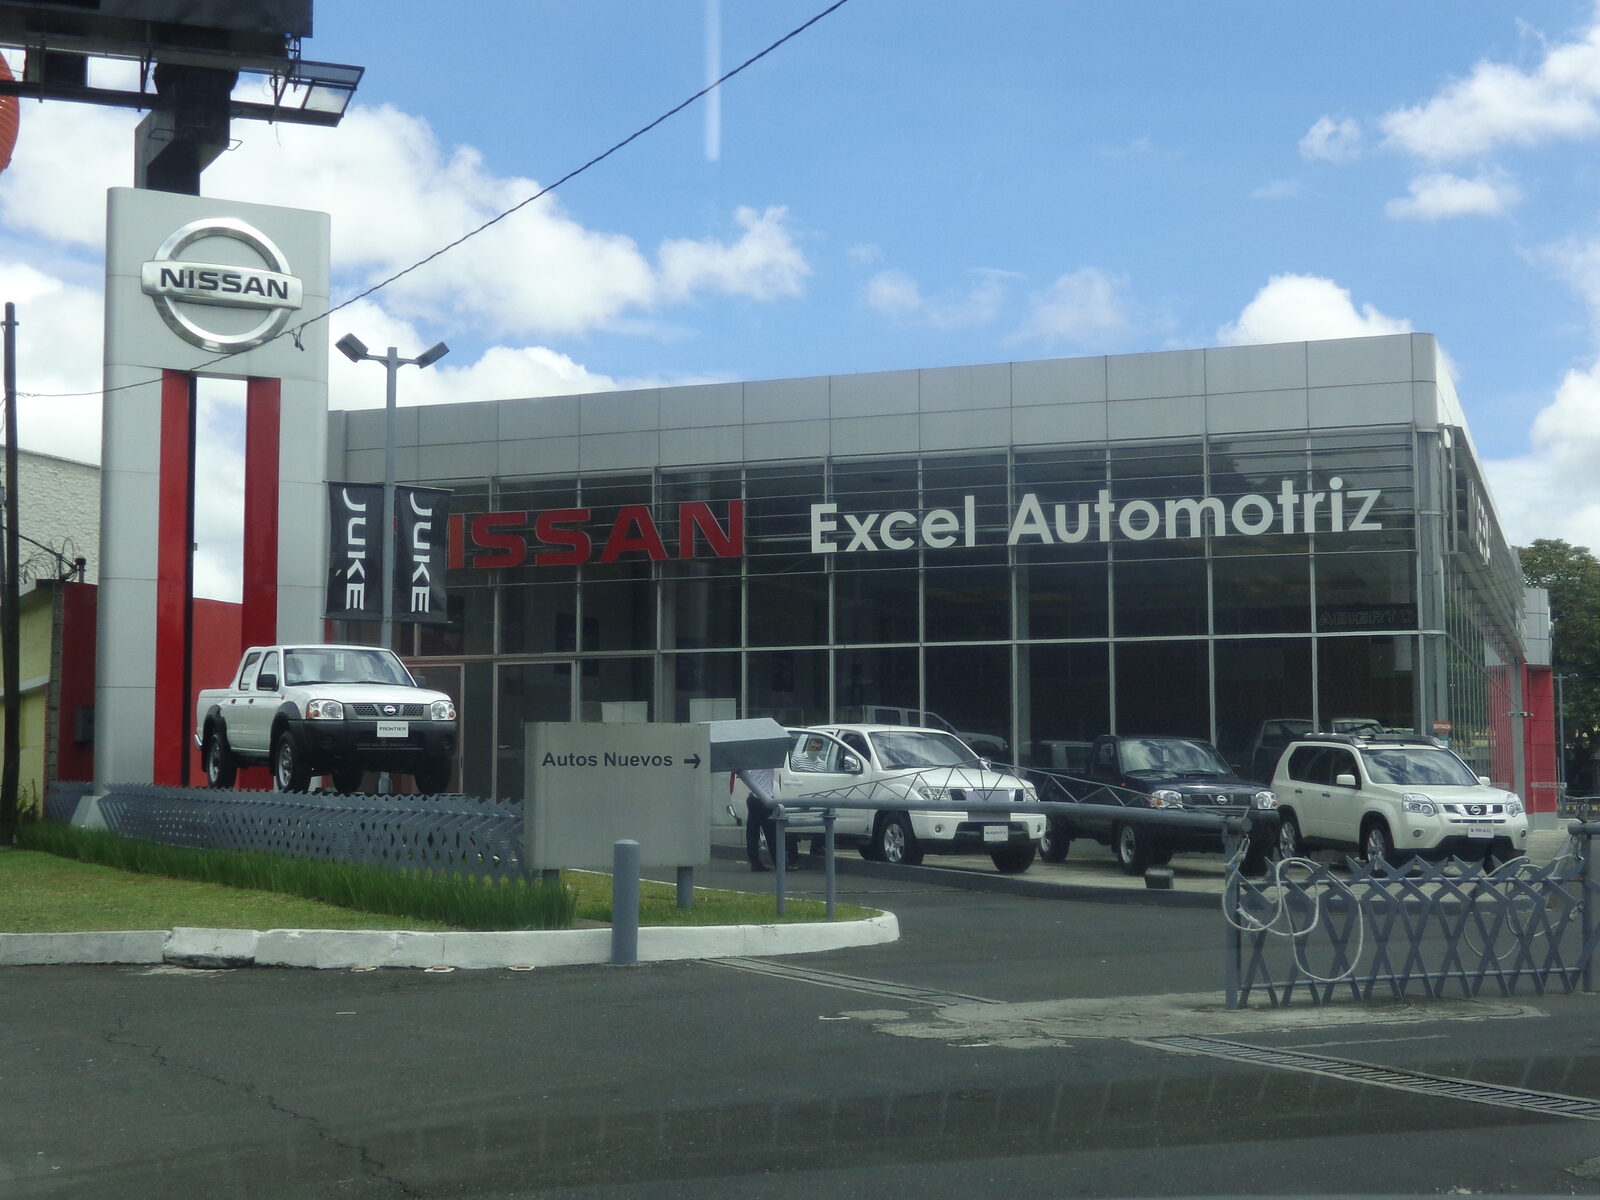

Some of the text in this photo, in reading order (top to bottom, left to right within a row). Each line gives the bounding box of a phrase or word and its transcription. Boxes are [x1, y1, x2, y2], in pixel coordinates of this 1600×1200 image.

[160, 267, 288, 300] NISSAN
[342, 487, 366, 611] JUKE
[409, 491, 432, 614] JUKE
[446, 476, 1383, 570] ISSAN Excel Automotriz
[542, 752, 673, 767] Autos Nuevos
